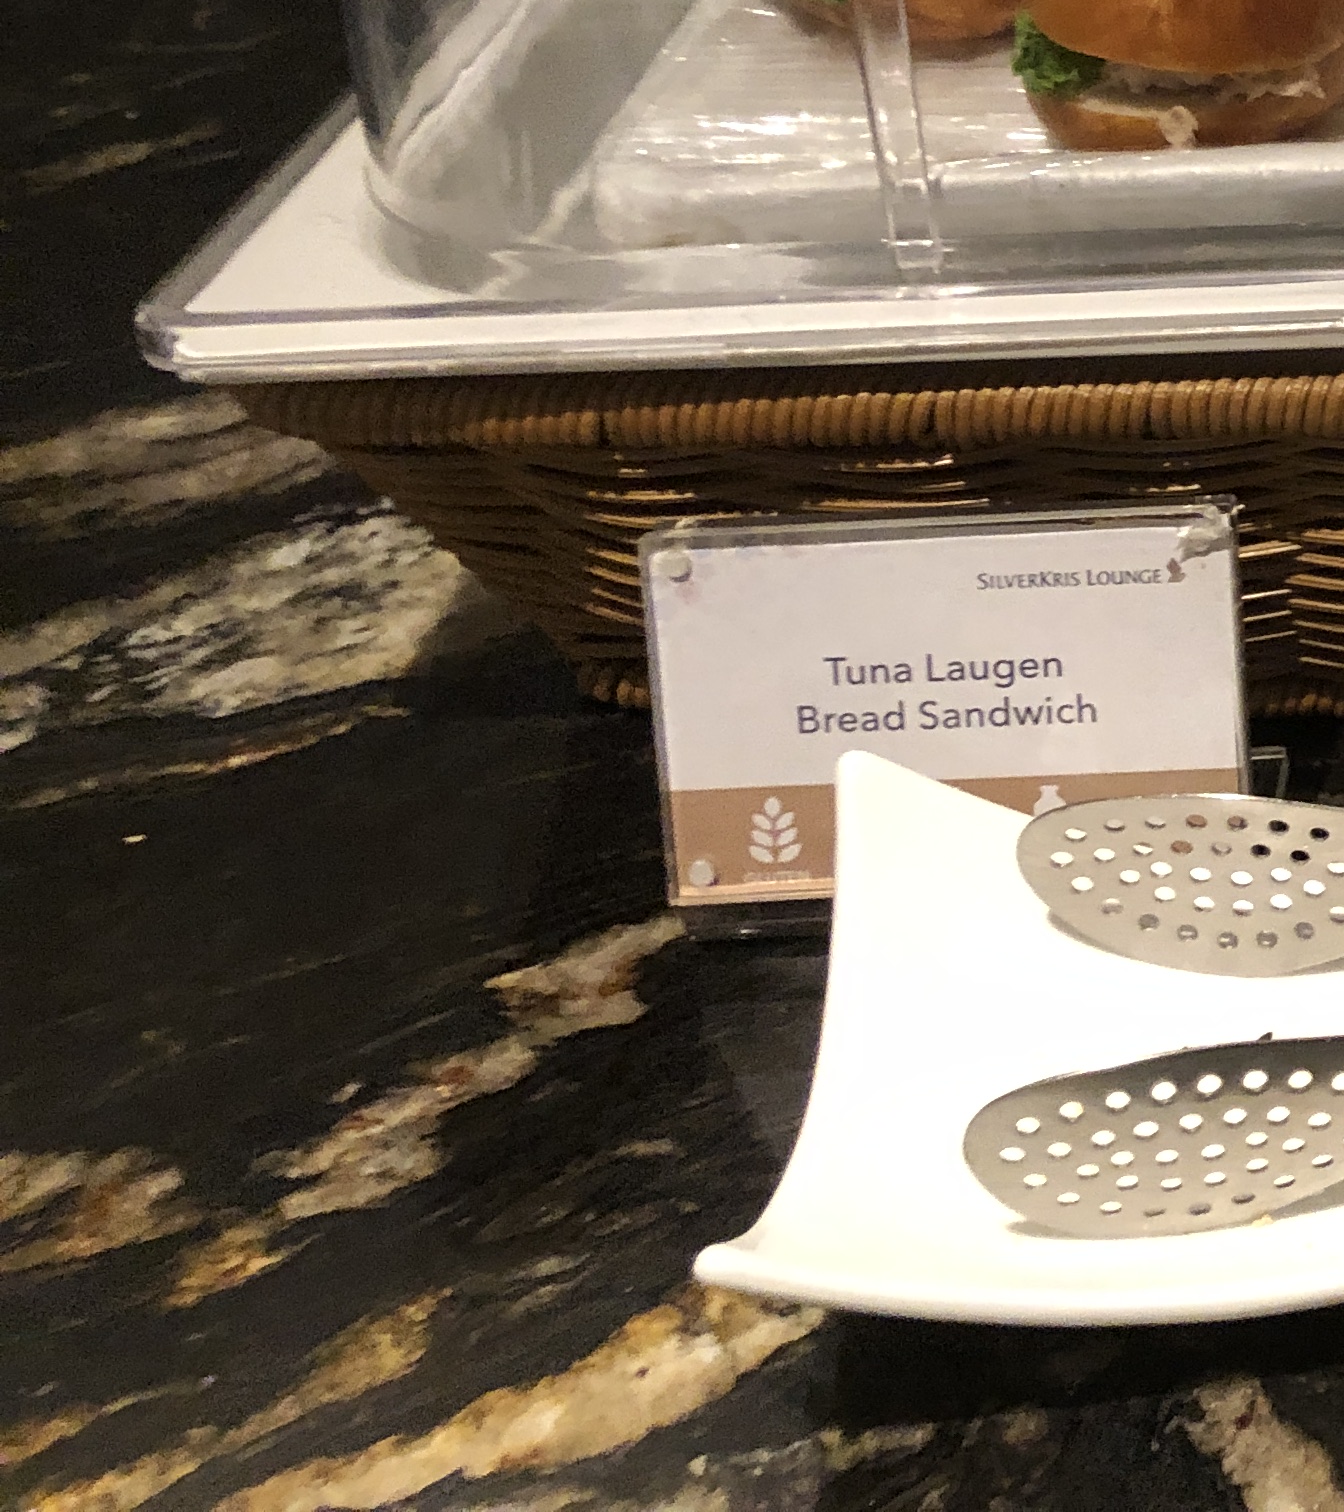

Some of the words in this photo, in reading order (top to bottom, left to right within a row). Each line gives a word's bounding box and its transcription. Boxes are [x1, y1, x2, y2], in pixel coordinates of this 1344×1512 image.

[1086, 566, 1163, 587] LOUNGE
[823, 656, 913, 686] Tuna
[925, 653, 1064, 688] Laugen
[797, 700, 905, 735] Bread
[918, 693, 1098, 730] Sandwich
